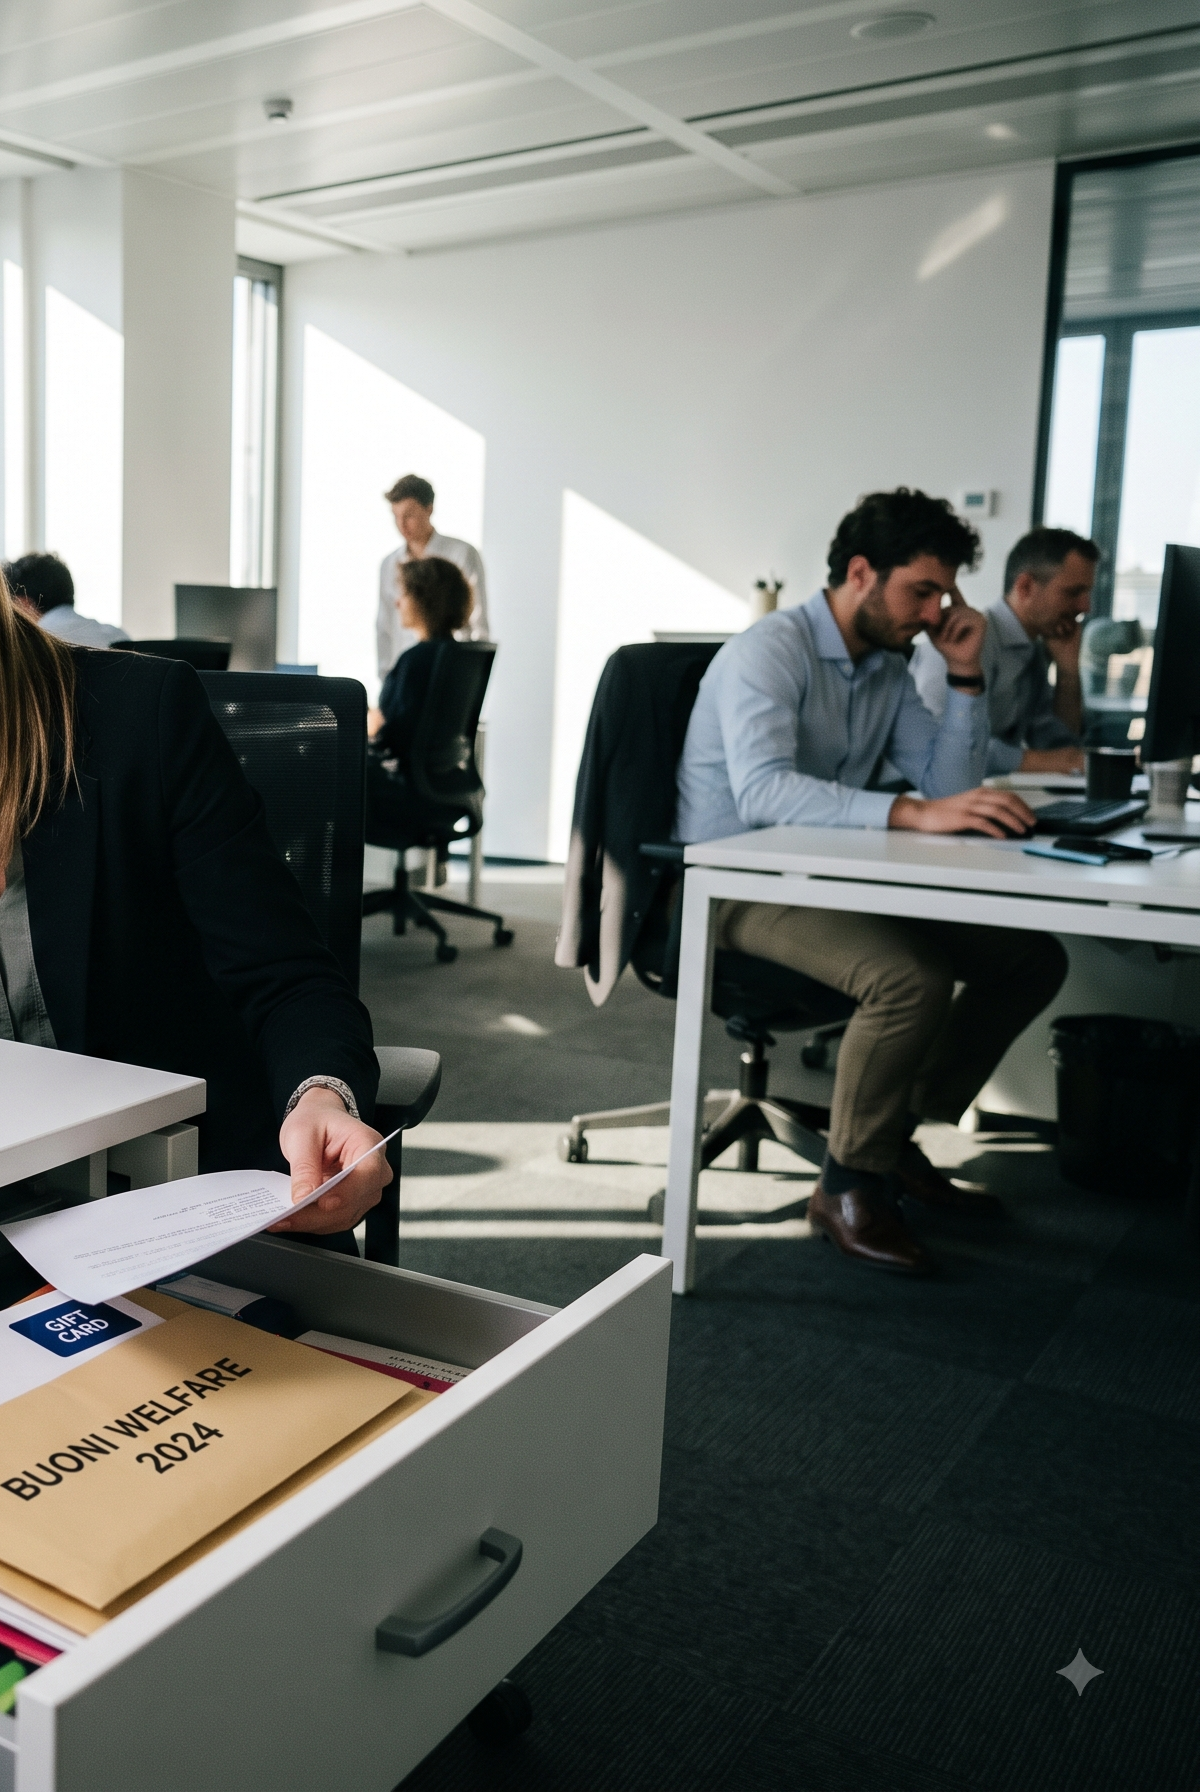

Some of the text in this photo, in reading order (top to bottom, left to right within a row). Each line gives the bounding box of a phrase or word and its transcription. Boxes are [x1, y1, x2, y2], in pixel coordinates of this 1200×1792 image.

[45, 1309, 89, 1333] GIFT
[57, 1318, 109, 1343] CARD
[0, 1433, 120, 1501] BUONI
[103, 1357, 252, 1438] WELFARE
[136, 1421, 224, 1474] 2024
